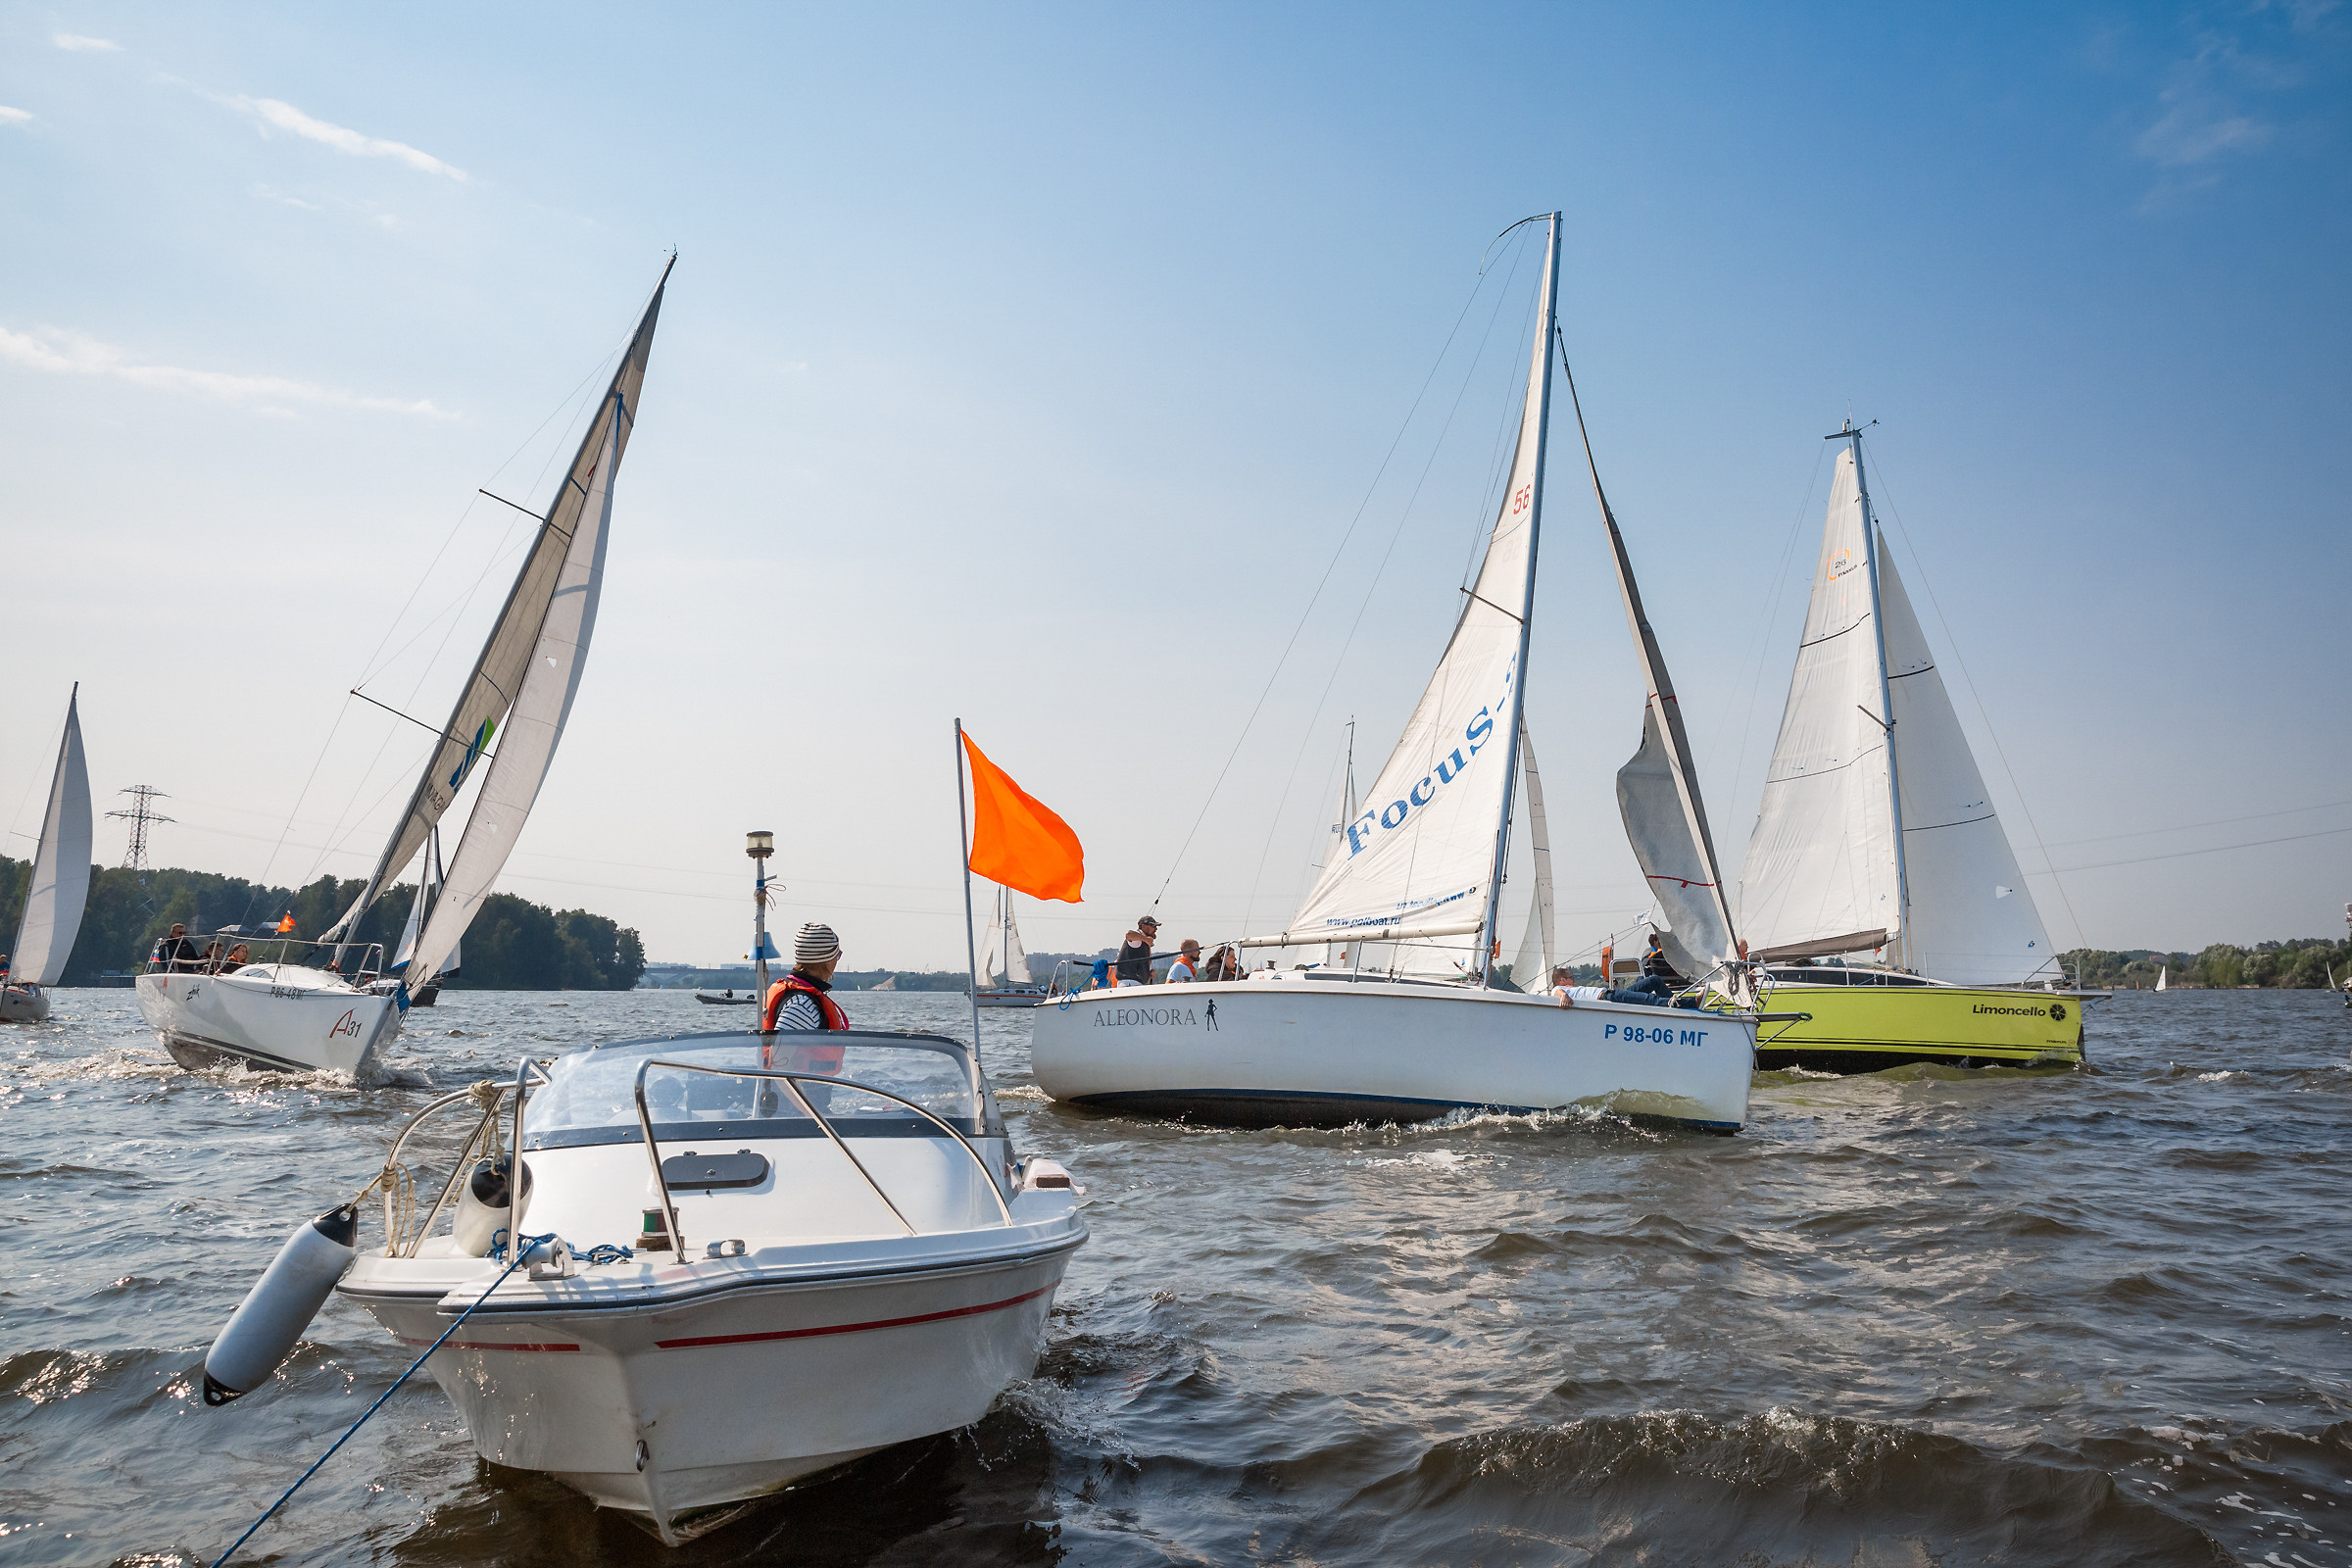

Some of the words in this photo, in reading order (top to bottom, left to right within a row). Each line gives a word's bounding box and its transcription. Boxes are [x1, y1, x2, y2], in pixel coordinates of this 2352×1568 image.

[1513, 483, 1531, 514] 56
[1326, 916, 1401, 928] www.polboat.ru
[1094, 1008, 1198, 1027] ALEONORA
[1972, 1004, 2046, 1017] Limoncello
[1623, 1026, 1674, 1044] 98-06
